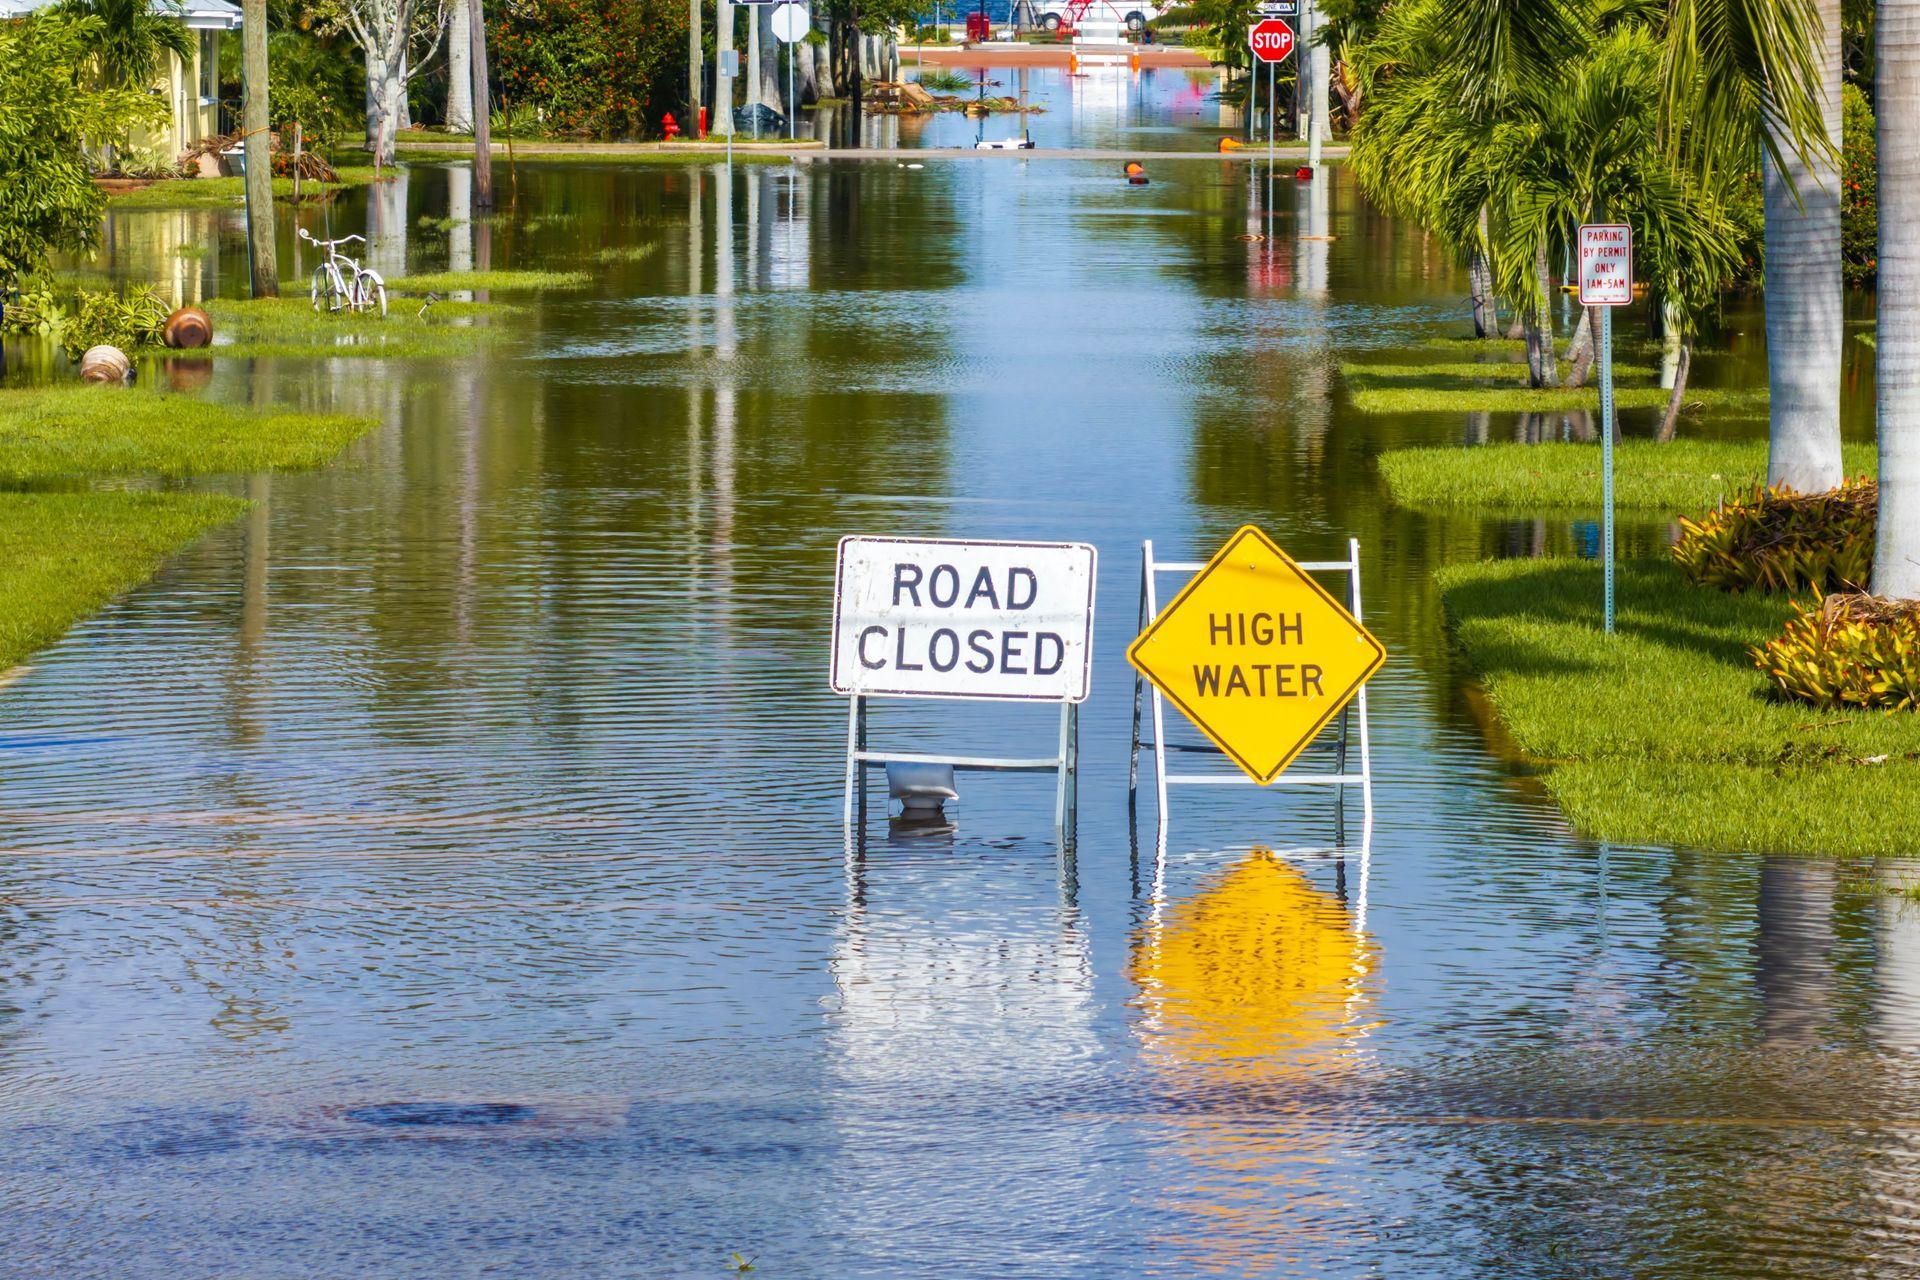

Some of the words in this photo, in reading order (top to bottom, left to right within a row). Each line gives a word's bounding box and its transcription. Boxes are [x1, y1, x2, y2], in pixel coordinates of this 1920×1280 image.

[1254, 32, 1291, 49] STOP
[1587, 231, 1623, 242] PARKING
[1583, 247, 1596, 258] BY
[1598, 247, 1627, 258] PERMIT
[1595, 263, 1616, 273] ONLY
[1586, 278, 1625, 289] 1AM-5AM
[892, 563, 1038, 611] ROAD
[1209, 612, 1304, 646] HIGH
[858, 625, 1065, 676] CLOSED
[1193, 664, 1324, 698] WATER
